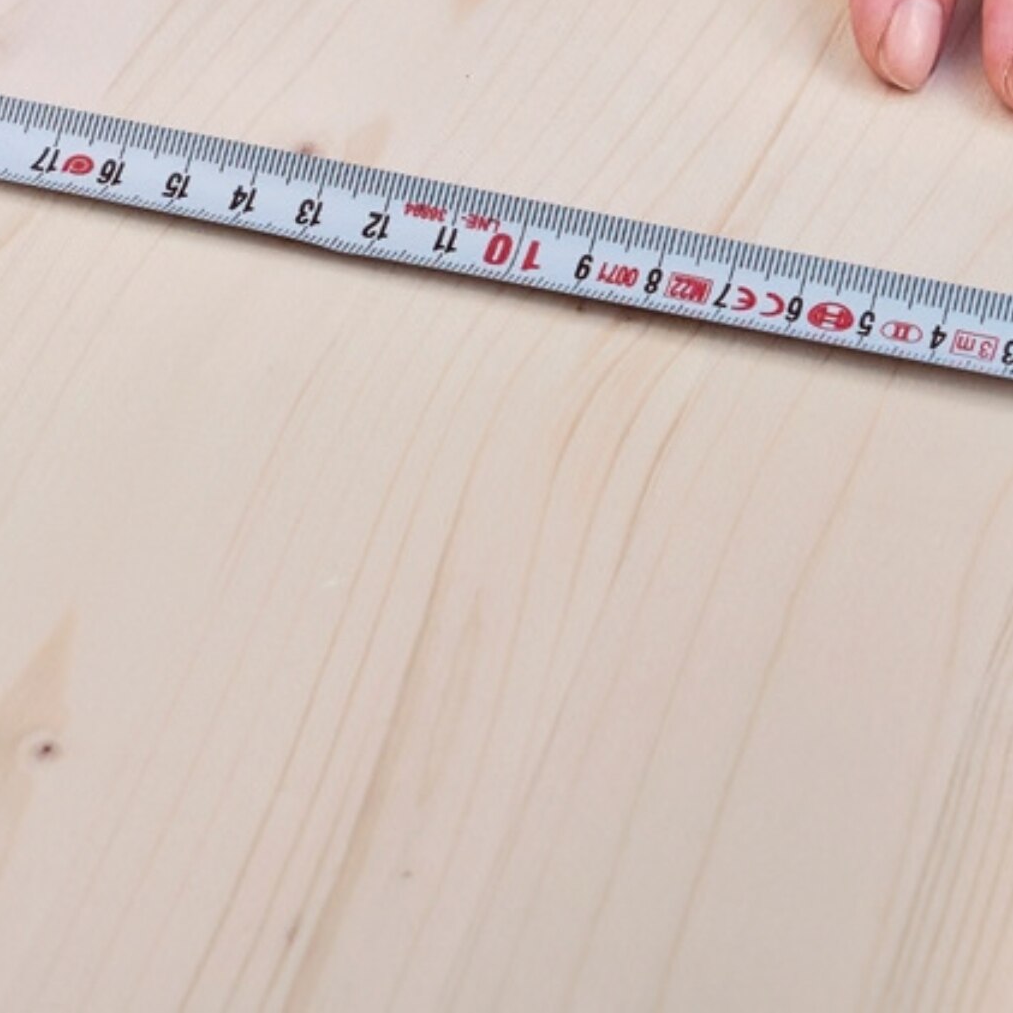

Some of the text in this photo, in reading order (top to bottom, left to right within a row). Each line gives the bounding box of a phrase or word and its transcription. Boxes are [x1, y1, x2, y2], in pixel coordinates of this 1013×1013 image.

[30, 146, 60, 173] 17
[96, 159, 126, 186] 16
[162, 173, 191, 199] 15
[228, 185, 258, 212] 14
[295, 199, 324, 226] 13
[362, 212, 390, 240] 12
[432, 225, 458, 253] 11
[483, 233, 541, 270] 10
[574, 254, 594, 280] 9
[643, 268, 663, 294] 8
[712, 283, 732, 309] 7
[784, 296, 804, 323] 6
[857, 311, 876, 336] 5
[929, 324, 948, 349] 4
